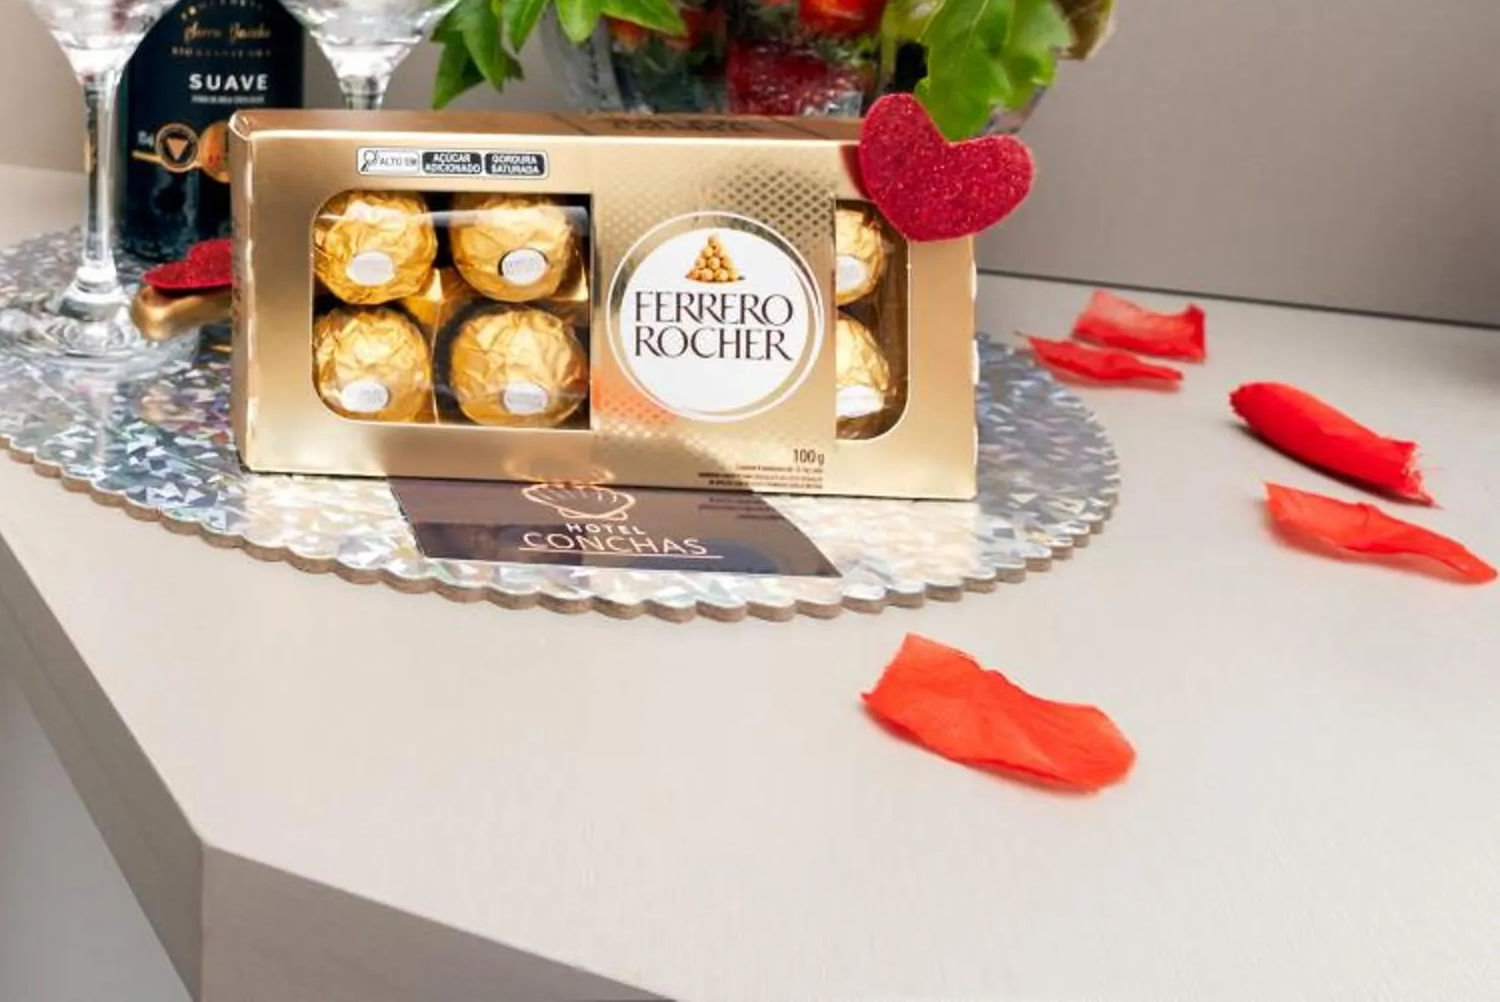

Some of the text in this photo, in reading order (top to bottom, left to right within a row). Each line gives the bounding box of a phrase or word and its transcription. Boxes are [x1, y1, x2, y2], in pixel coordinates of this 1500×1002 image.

[188, 73, 269, 91] SUAVE
[635, 291, 793, 326] FERRERO
[635, 325, 793, 360] ROCHER
[566, 522, 645, 535] HOTEL
[523, 532, 708, 555] CONCHAS
